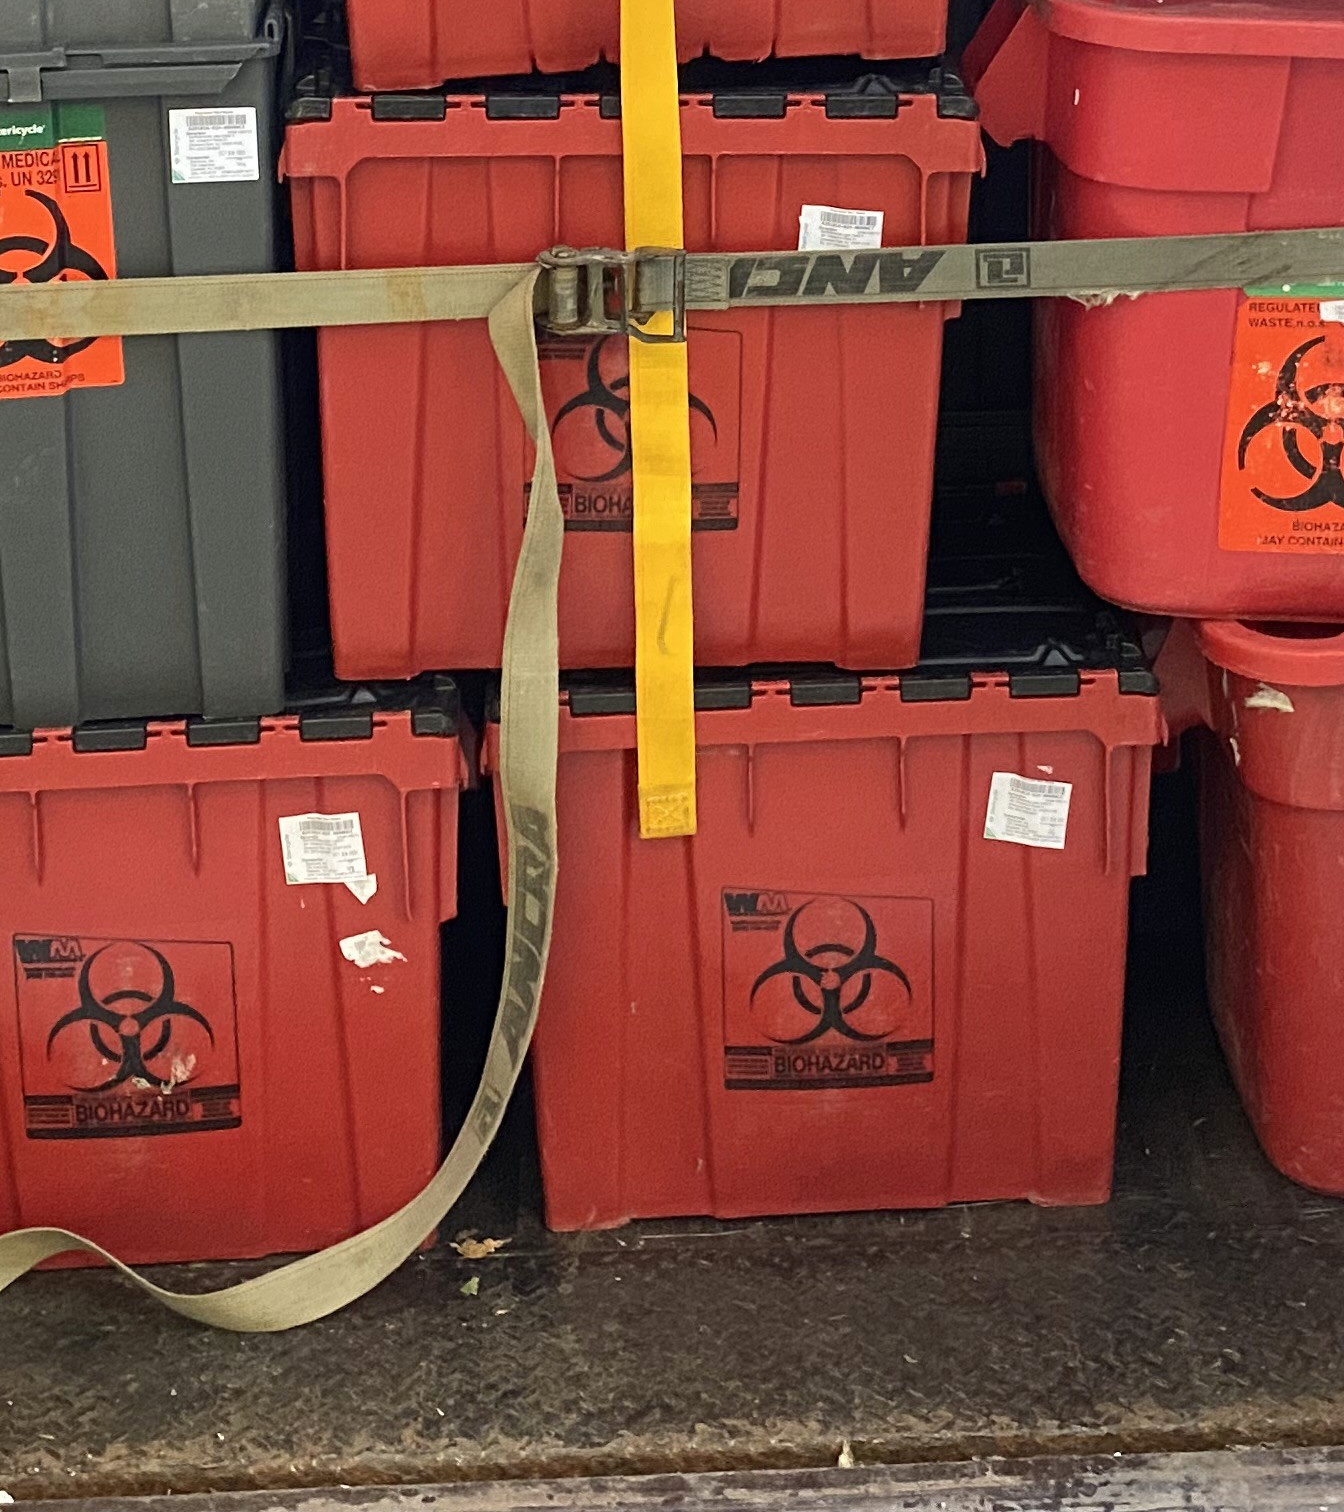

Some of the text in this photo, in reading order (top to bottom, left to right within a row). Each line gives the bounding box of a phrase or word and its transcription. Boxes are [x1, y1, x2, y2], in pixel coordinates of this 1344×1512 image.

[11, 171, 33, 187] UN
[728, 249, 946, 299] ANC
[1288, 536, 1343, 547] CONTAIN
[773, 1052, 886, 1074] BIOHAZARD
[75, 1098, 190, 1124] BIOHAZARD
